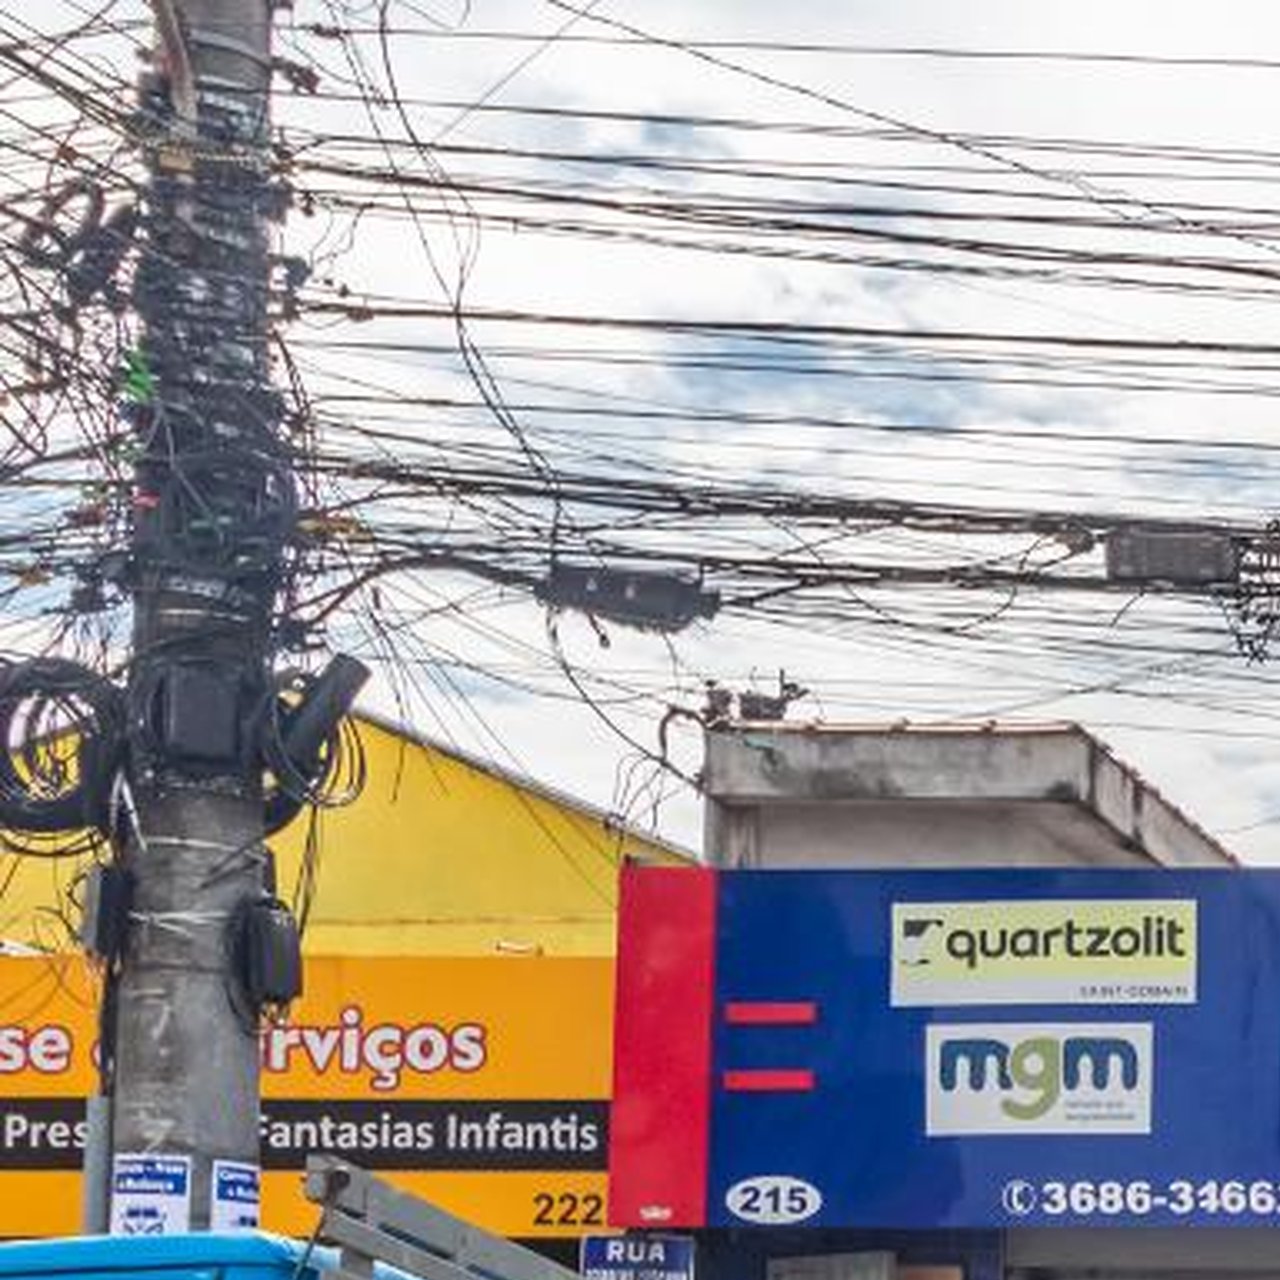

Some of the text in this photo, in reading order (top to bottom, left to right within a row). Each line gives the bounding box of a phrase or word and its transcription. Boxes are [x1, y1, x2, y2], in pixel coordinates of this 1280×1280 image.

[945, 916, 1187, 969] quartzolit
[939, 1036, 1139, 1121] mgm
[447, 1112, 598, 1150] Infantis
[533, 1193, 604, 1226] 222
[740, 1186, 808, 1216] 215
[607, 1240, 665, 1262] RUA
